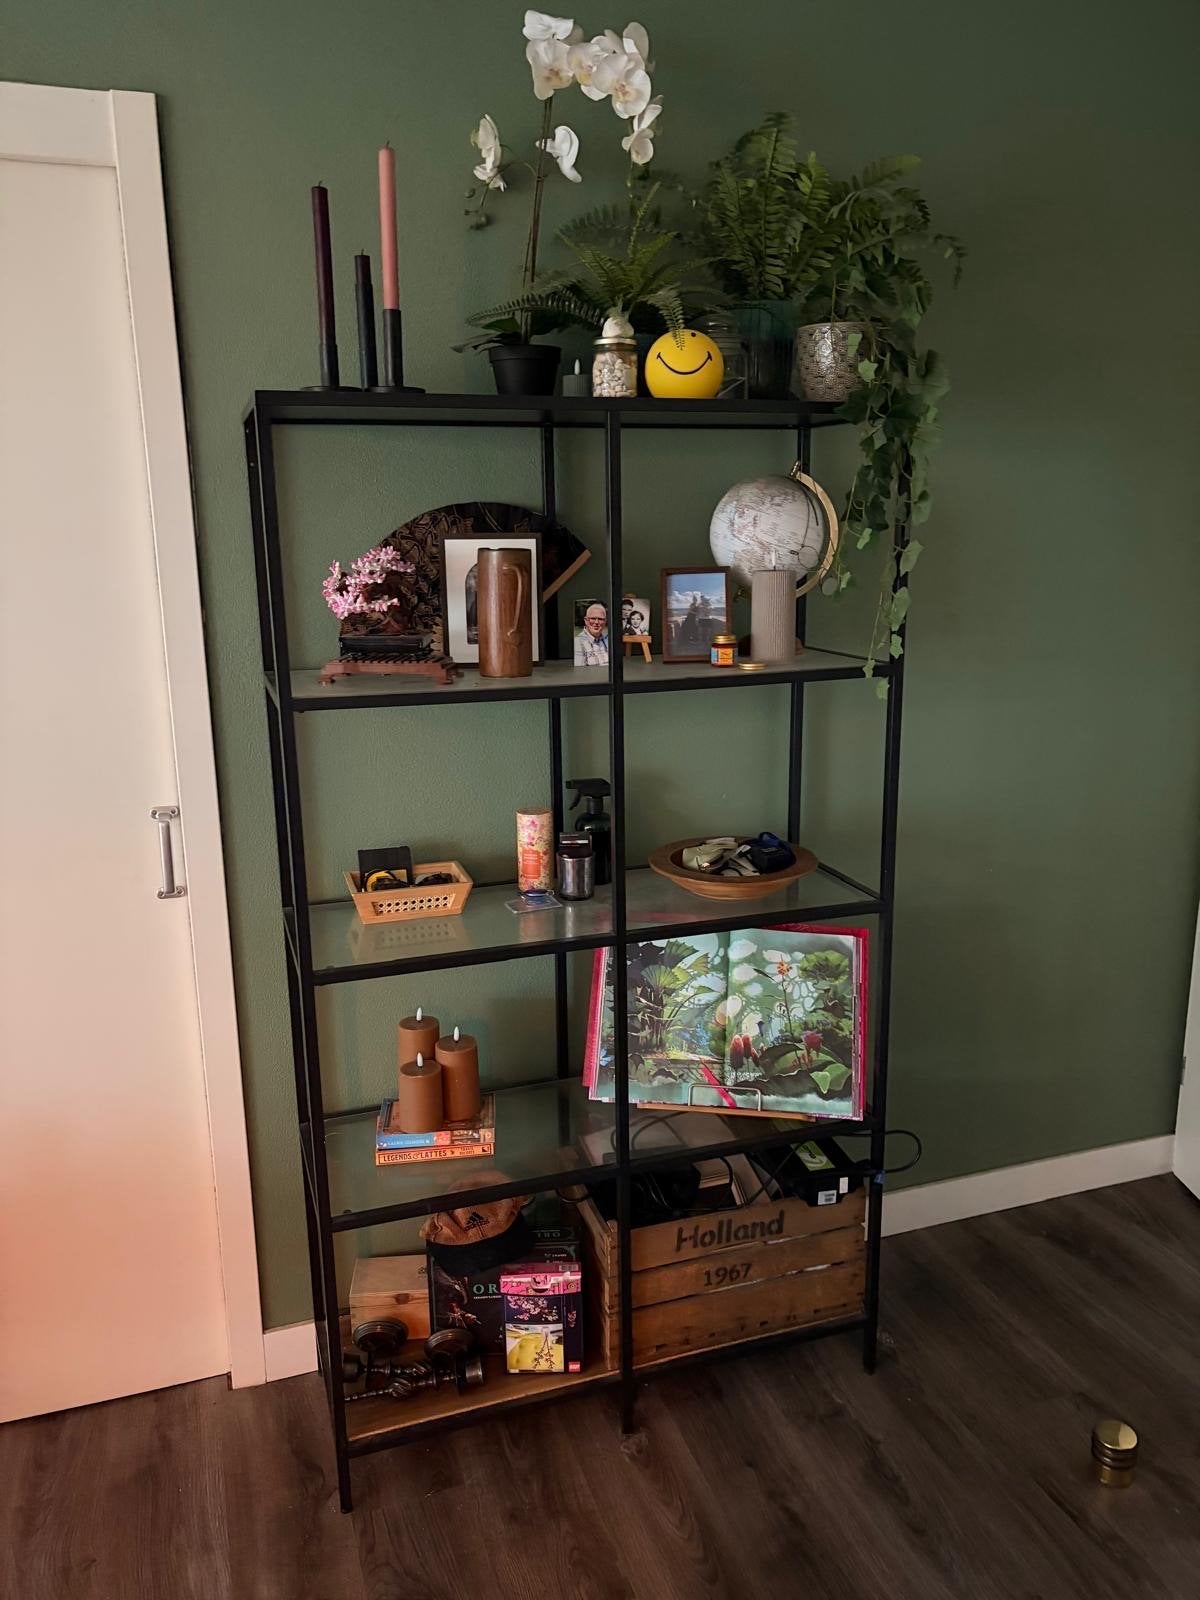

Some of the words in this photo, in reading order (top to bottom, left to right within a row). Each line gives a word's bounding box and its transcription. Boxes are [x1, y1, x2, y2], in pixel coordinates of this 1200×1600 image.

[383, 1152, 412, 1162] LEGENDS
[420, 1150, 447, 1160] LATTES
[675, 1209, 785, 1252] Holland
[704, 1262, 753, 1287] 1967
